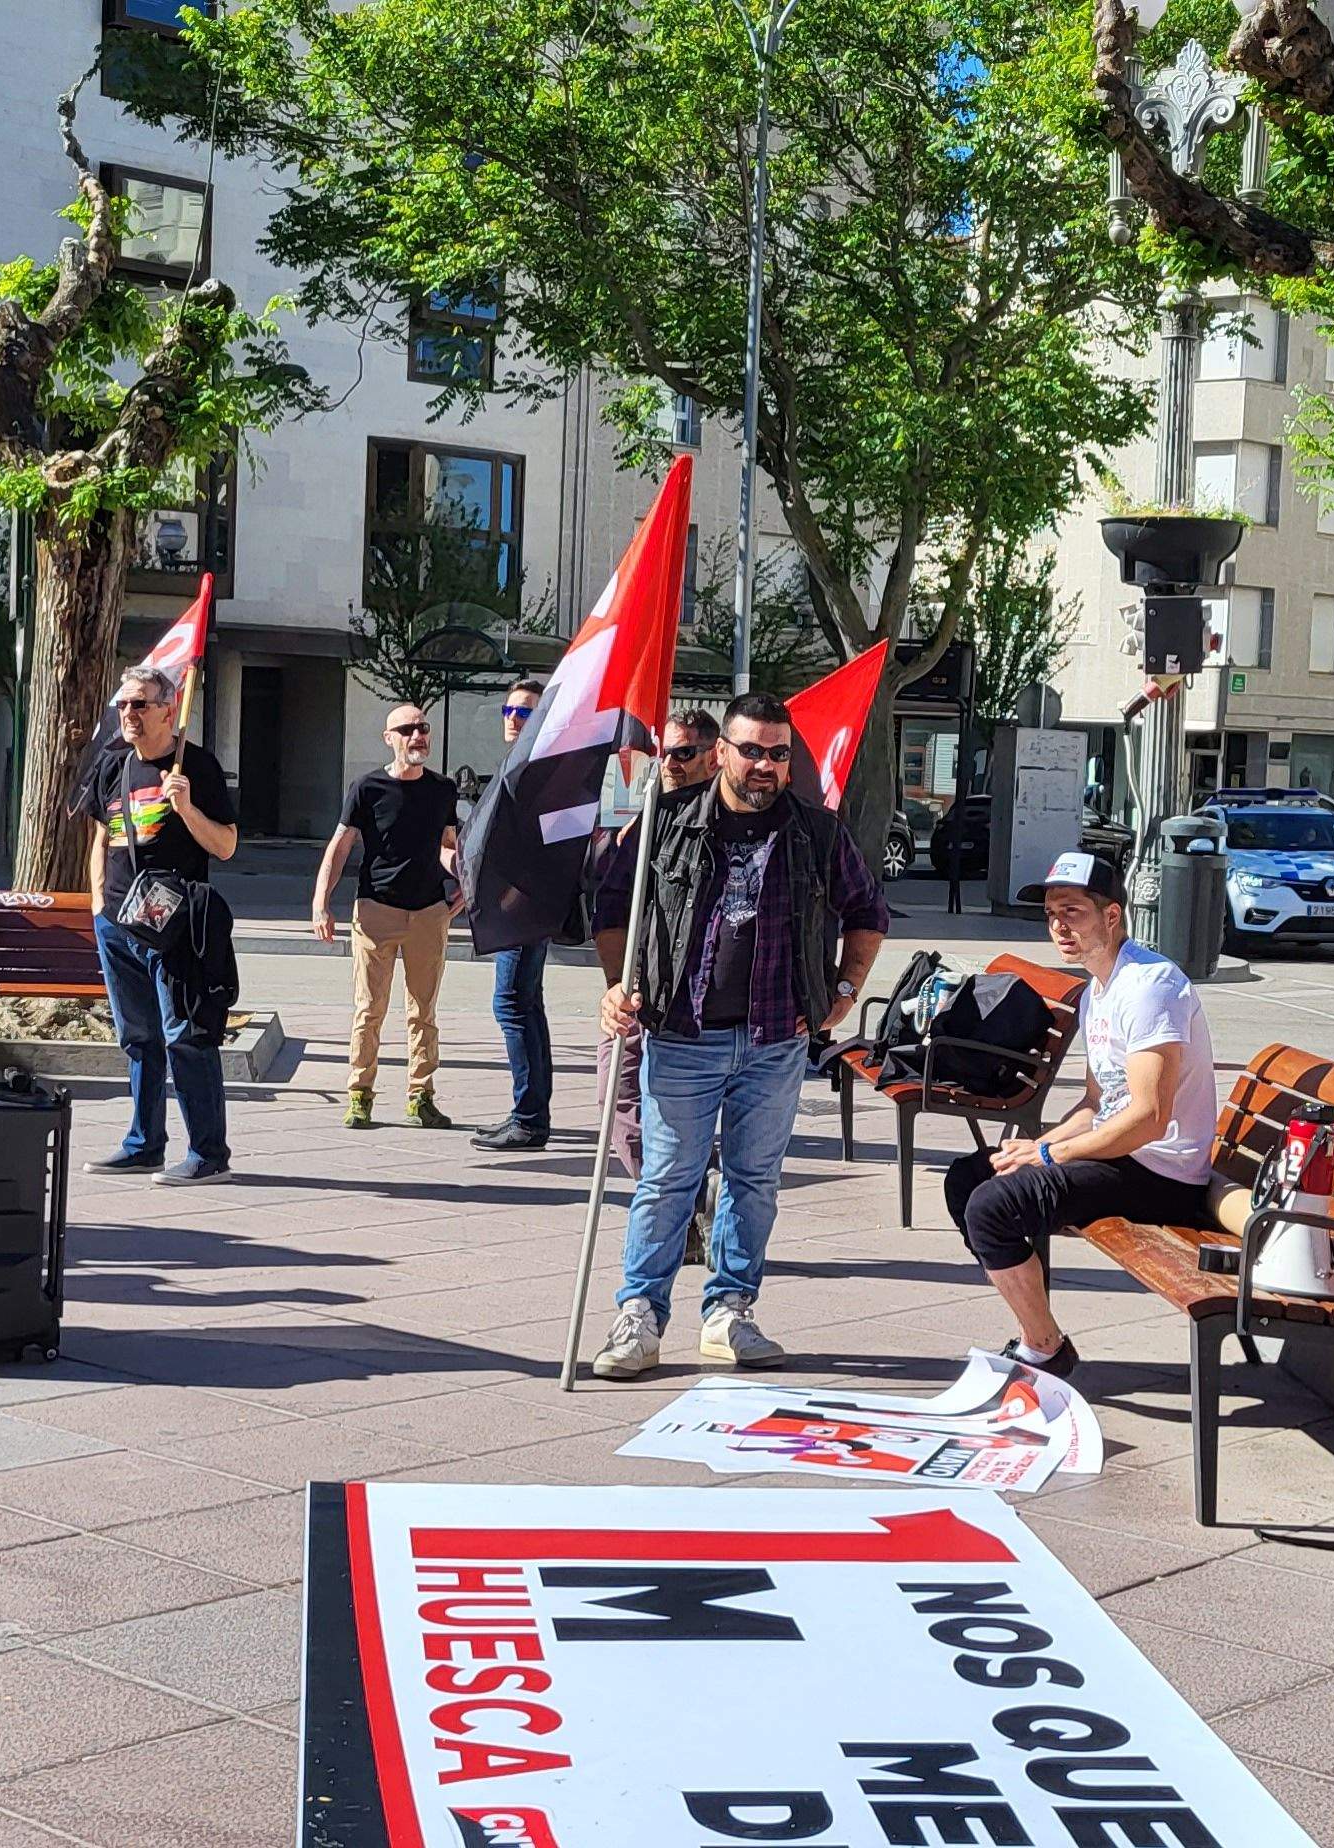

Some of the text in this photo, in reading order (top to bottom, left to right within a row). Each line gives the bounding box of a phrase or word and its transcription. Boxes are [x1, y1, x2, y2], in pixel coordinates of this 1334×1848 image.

[923, 1448, 975, 1478] MAYO
[415, 1565, 573, 1786] HUESCA
[897, 1582, 1223, 1848] NOS QUE
[682, 1791, 849, 1848] D
